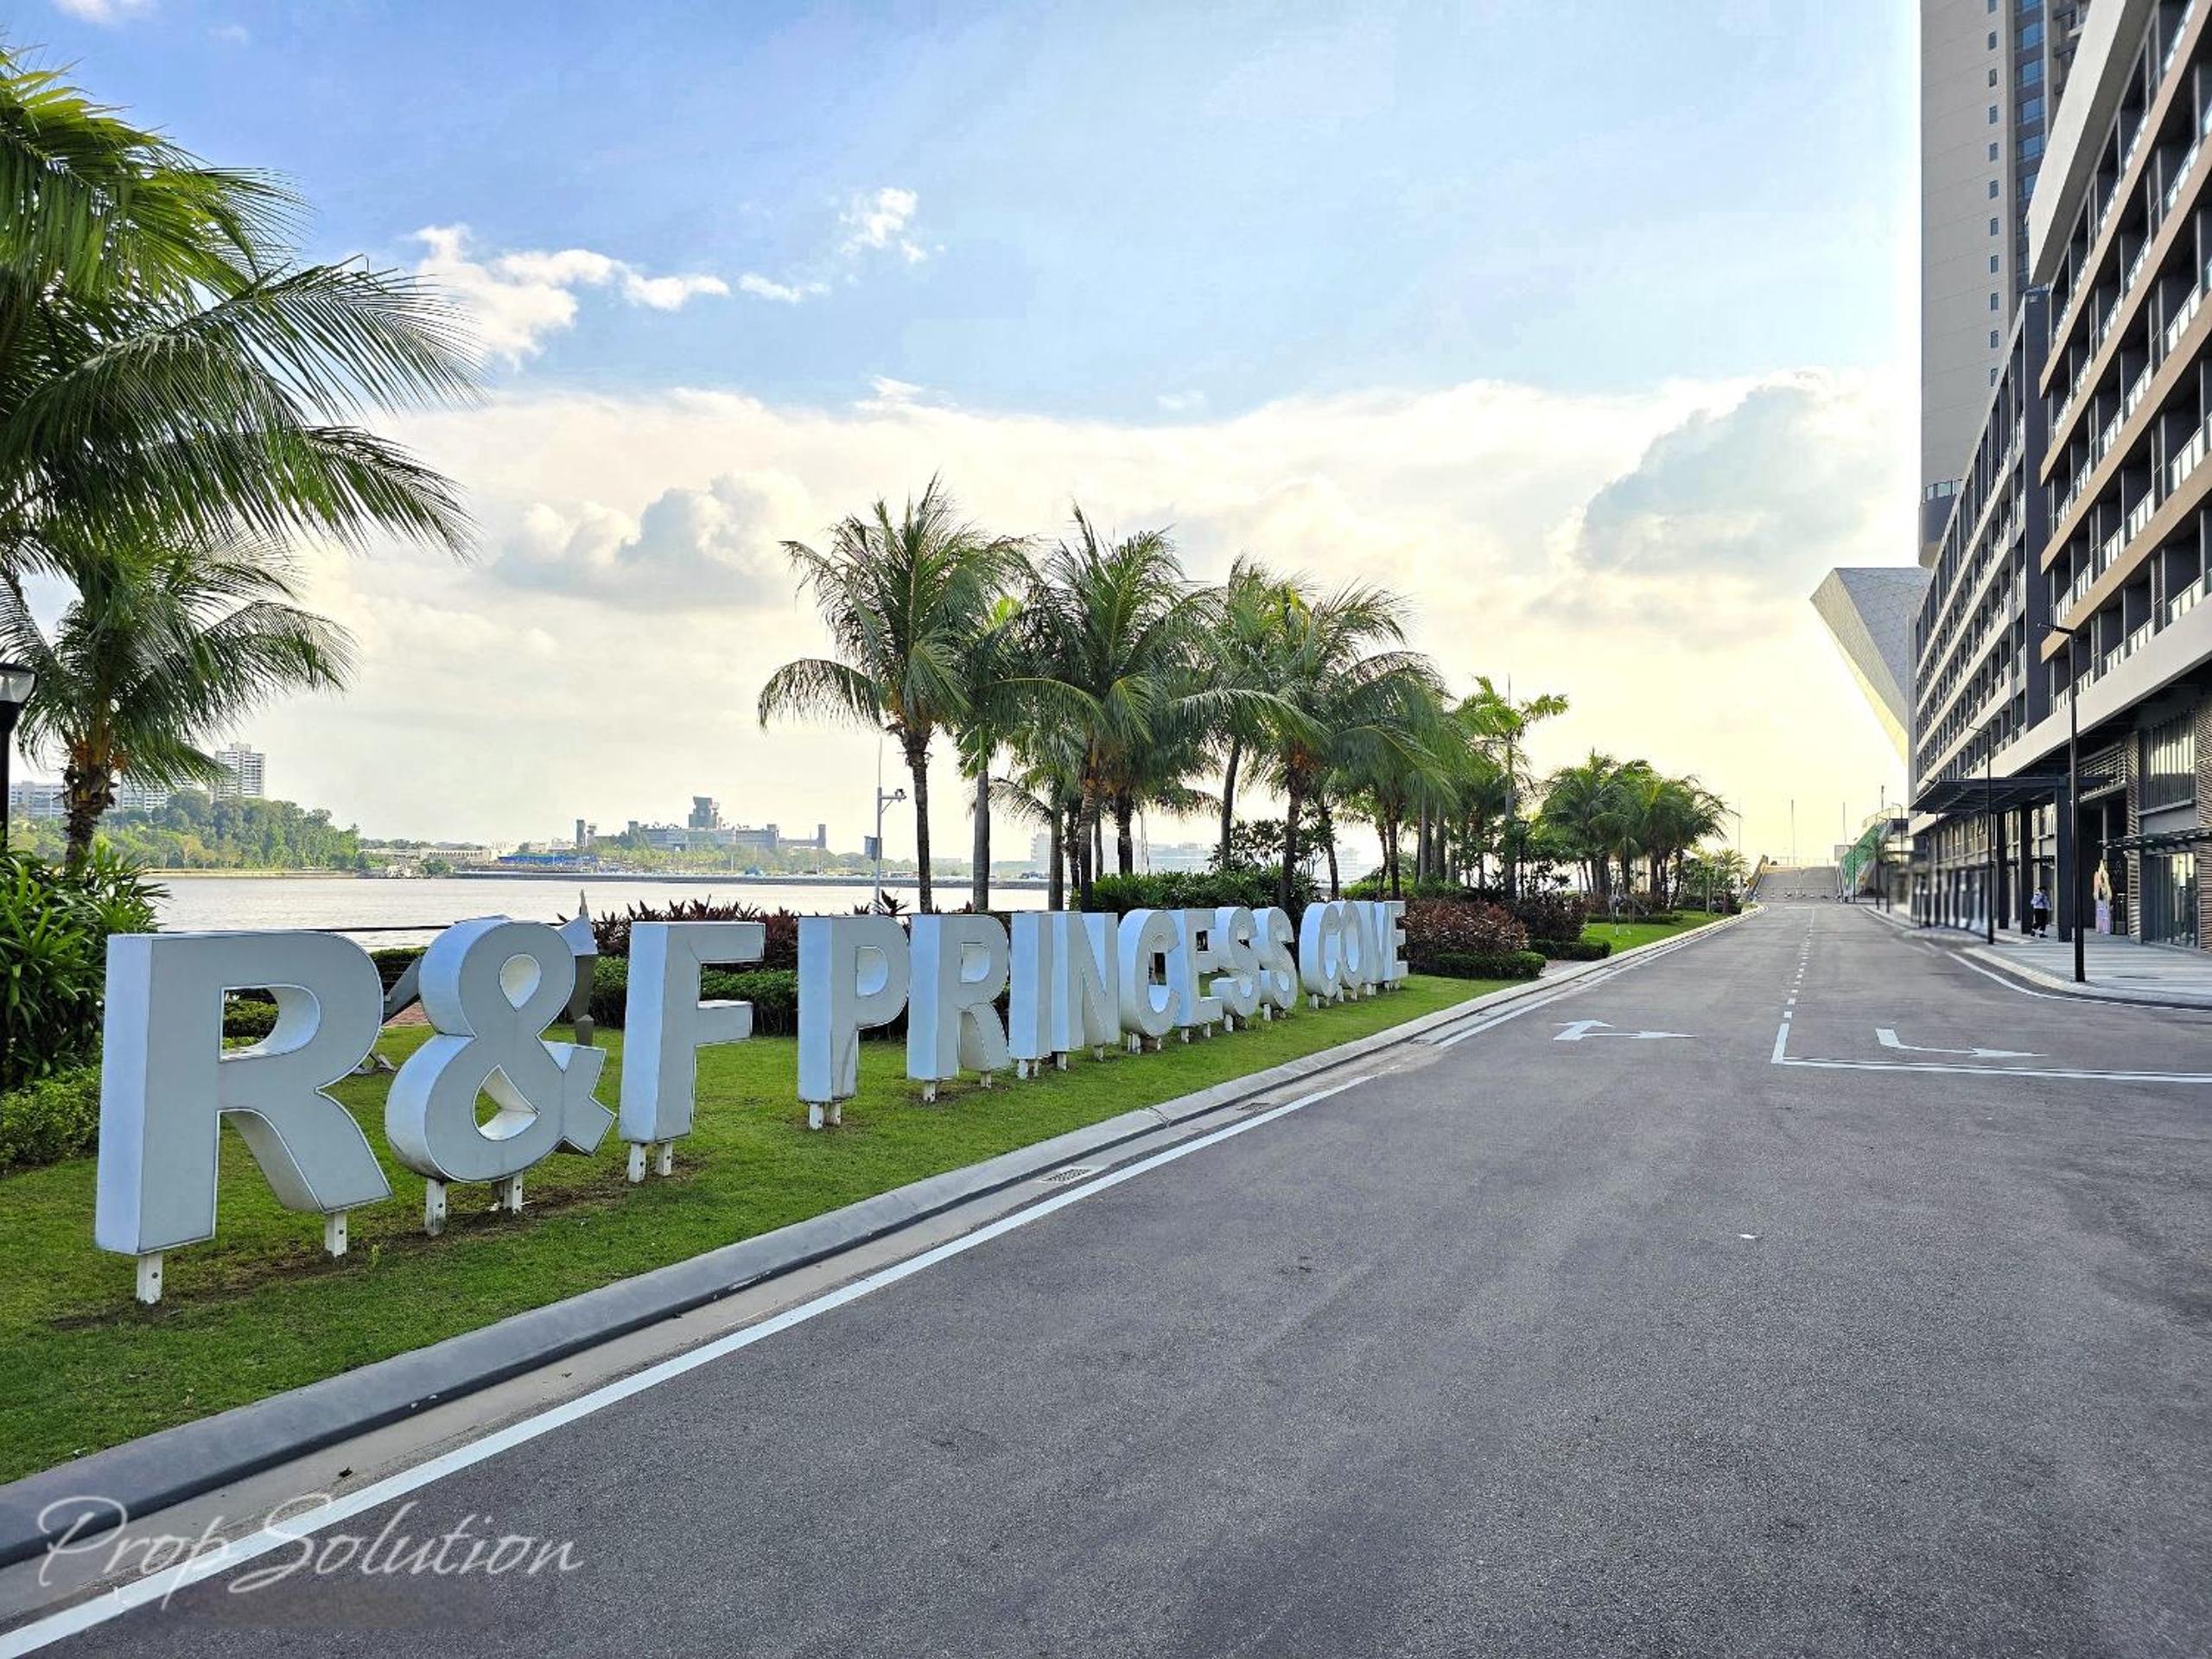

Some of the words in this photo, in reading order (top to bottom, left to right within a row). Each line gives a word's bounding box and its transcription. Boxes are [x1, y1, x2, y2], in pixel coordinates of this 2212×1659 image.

[96, 917, 765, 1254] R&F
[797, 906, 1298, 1103] PRINCESS
[1299, 899, 1408, 997] COVE
